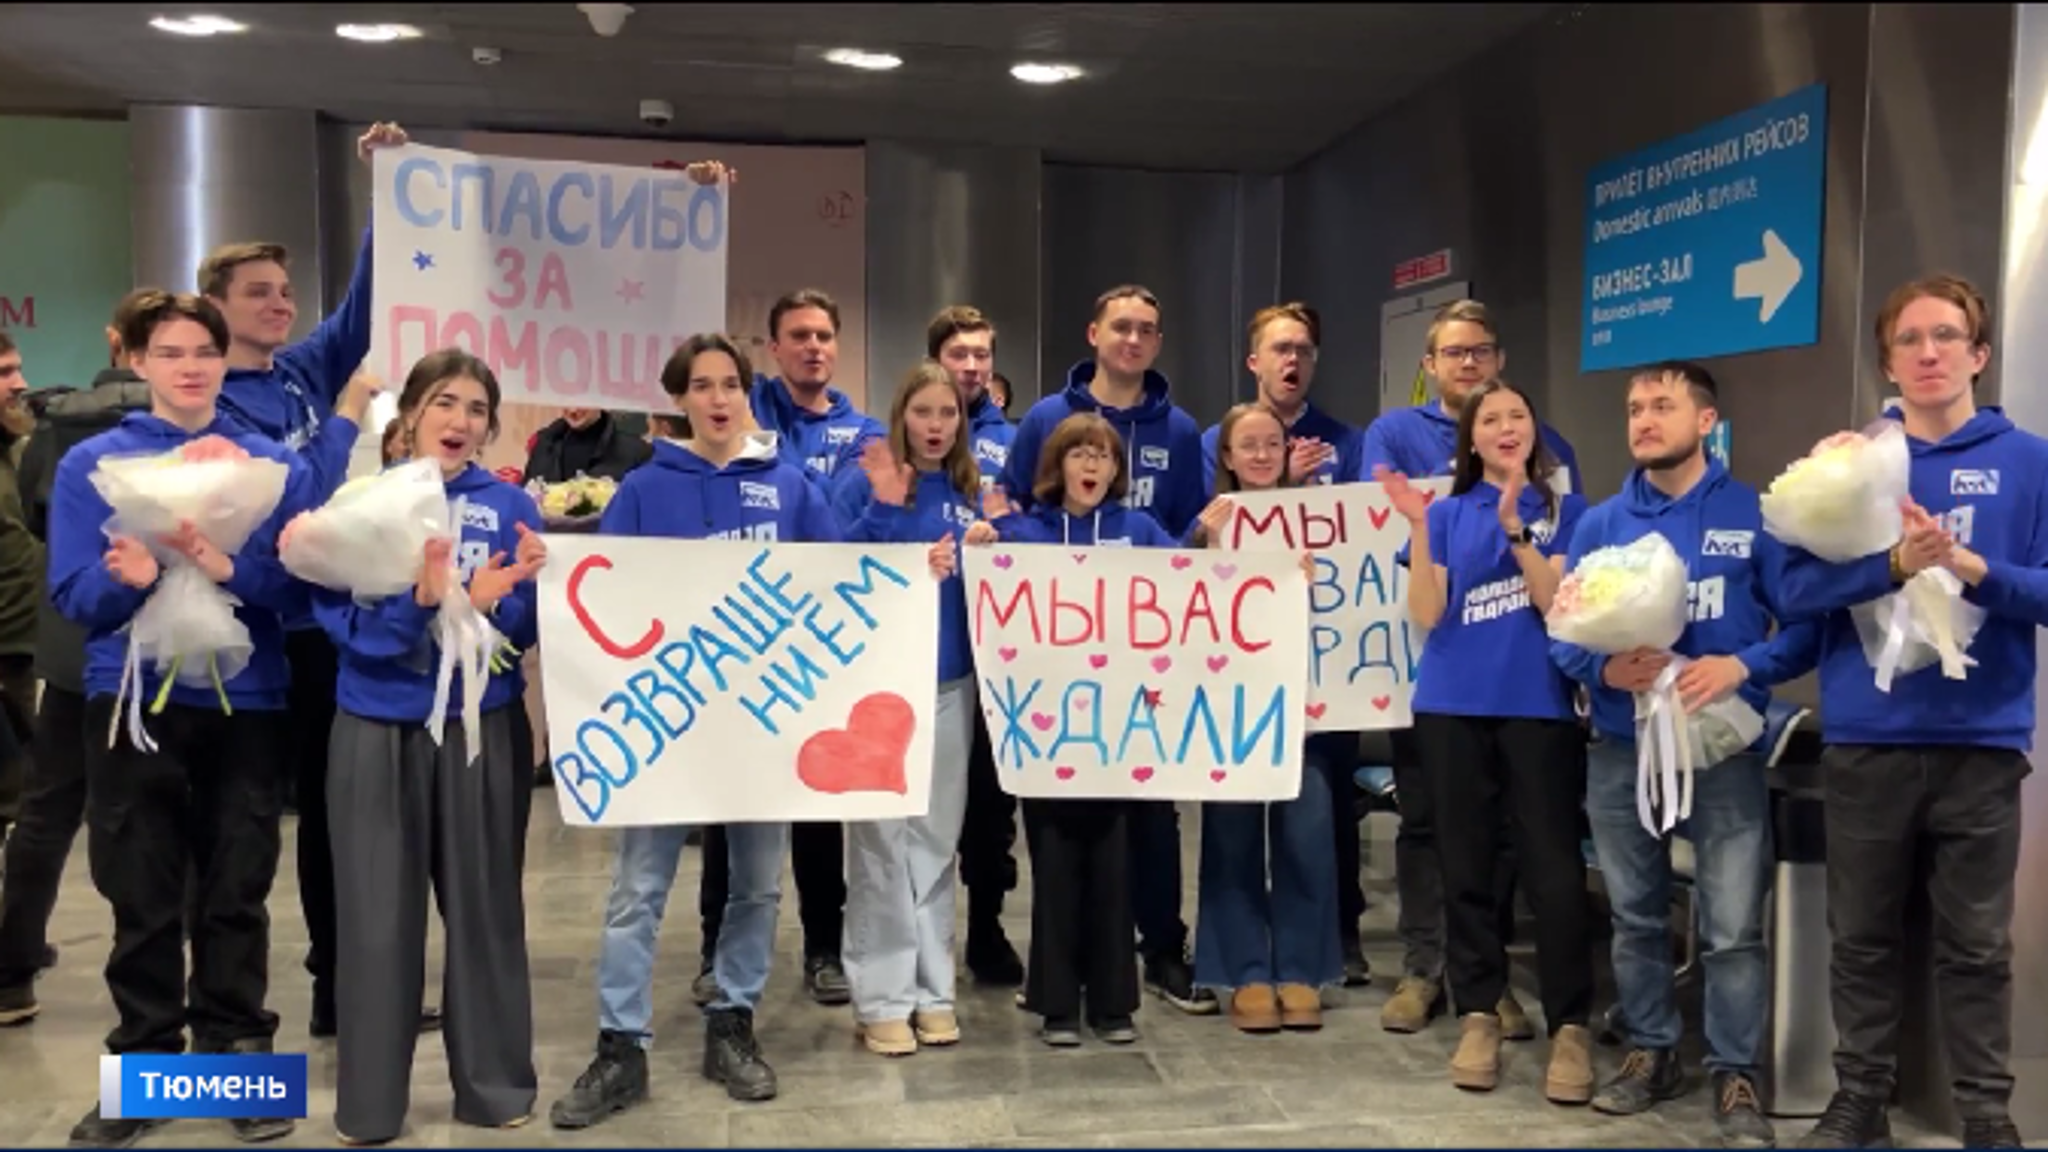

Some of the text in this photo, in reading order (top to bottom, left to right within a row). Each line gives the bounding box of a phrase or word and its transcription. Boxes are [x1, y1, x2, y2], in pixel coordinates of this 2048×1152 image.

[1646, 136, 1741, 190] ВНУТРЕННИХ
[1743, 112, 1810, 161] РЕЙСОВ
[392, 156, 723, 253] СПАСИБО
[1593, 205, 1651, 243] Domestic
[1652, 187, 1703, 226] arrivals
[486, 246, 574, 311] ЗА
[1591, 252, 1694, 301] БИЗНЕС-ЗАЛ
[388, 304, 690, 408] ПОМОЩ
[1231, 499, 1348, 551] МЫ
[566, 553, 666, 661] С
[738, 553, 911, 735] НИЕМ
[976, 575, 1277, 653] МЫ ВАС
[554, 548, 814, 823] ВОЗВРАЩЕ
[985, 675, 1287, 770] ЖДАЛИ
